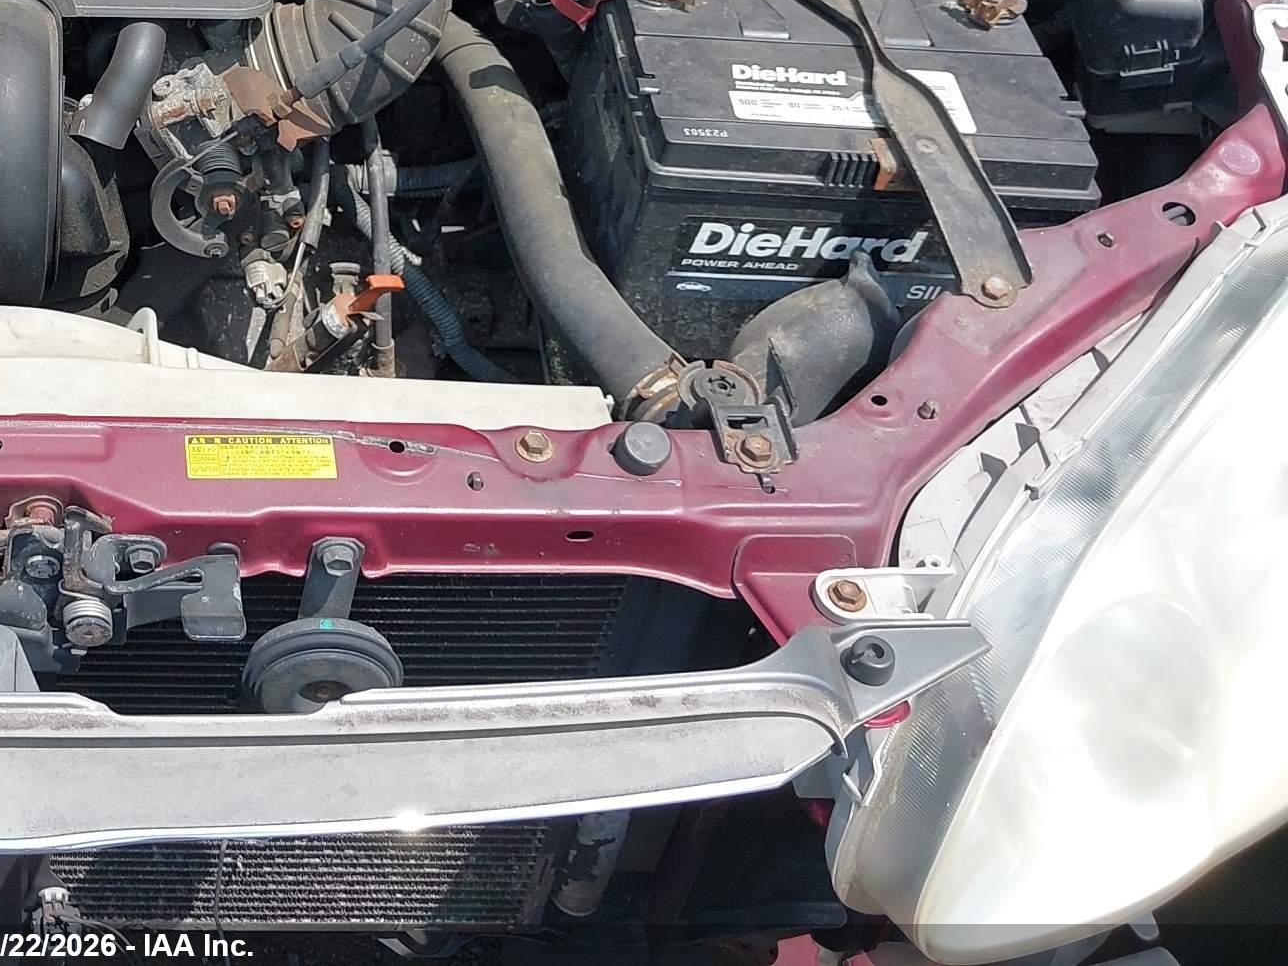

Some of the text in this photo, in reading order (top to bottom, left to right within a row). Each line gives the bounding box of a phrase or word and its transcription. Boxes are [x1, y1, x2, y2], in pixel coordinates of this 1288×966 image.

[731, 63, 848, 86] DieHard
[688, 222, 929, 263] DieHard
[680, 258, 799, 271] POWER AHEAD
